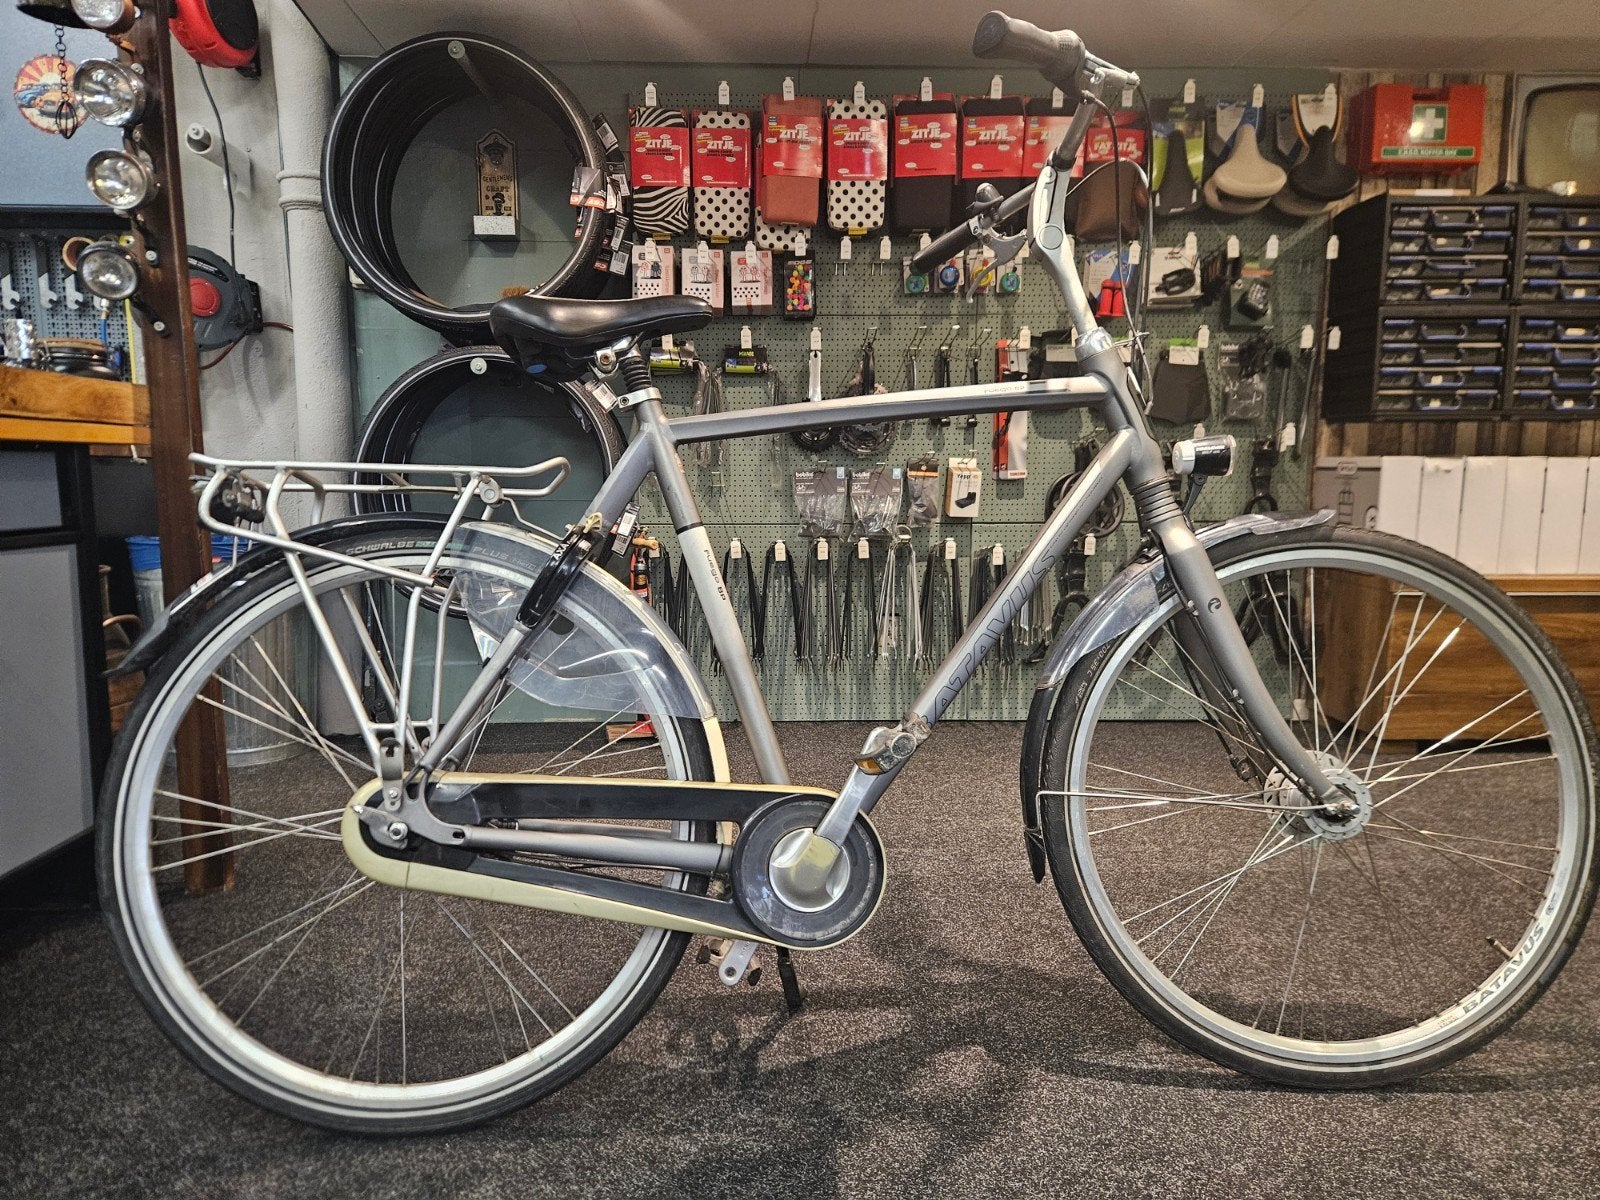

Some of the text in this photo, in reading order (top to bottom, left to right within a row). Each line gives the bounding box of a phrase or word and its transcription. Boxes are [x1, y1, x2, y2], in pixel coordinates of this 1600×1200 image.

[780, 129, 809, 139] ZITJE
[844, 131, 872, 141] ZITJE
[911, 128, 941, 139] ZITJE
[979, 129, 1008, 140] ZITJE
[645, 139, 673, 149] ZITJE
[706, 140, 734, 150] ZITJE
[346, 540, 415, 555] SCHWALBE
[472, 545, 509, 560] PLUS
[553, 542, 569, 561] AXA
[1462, 922, 1544, 1015] BATAVUS
